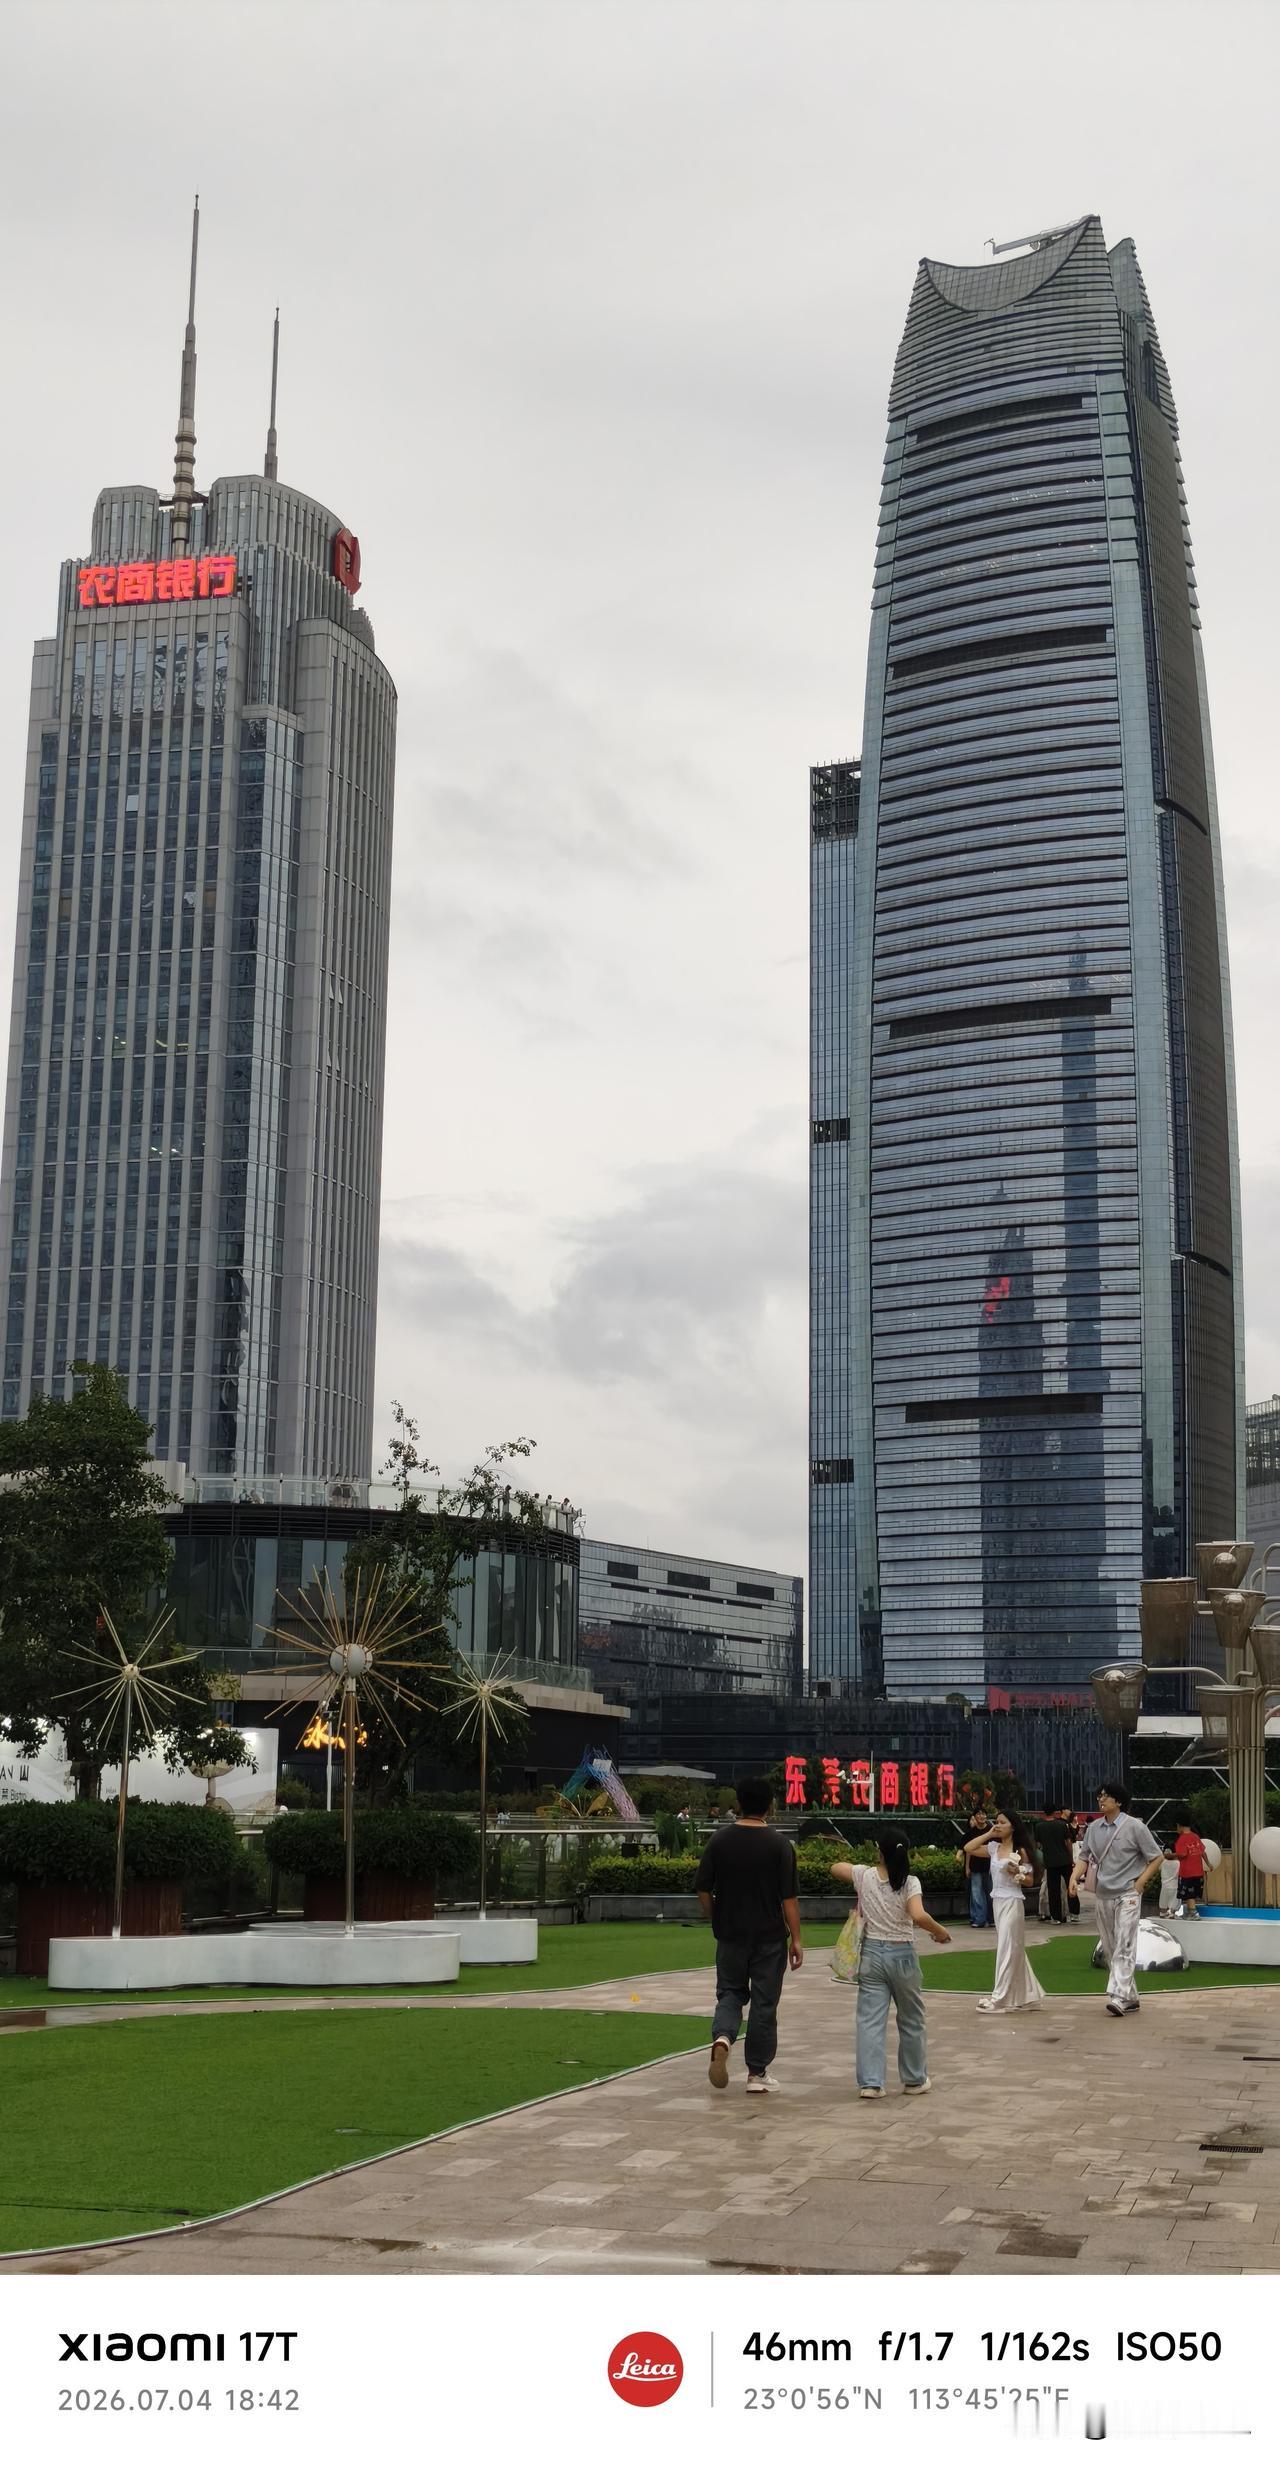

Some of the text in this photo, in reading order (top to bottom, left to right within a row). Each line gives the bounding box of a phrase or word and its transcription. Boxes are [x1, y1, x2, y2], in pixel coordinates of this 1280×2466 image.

[79, 555, 237, 607] 农商银行
[785, 1755, 955, 1806] 东莞农商银行
